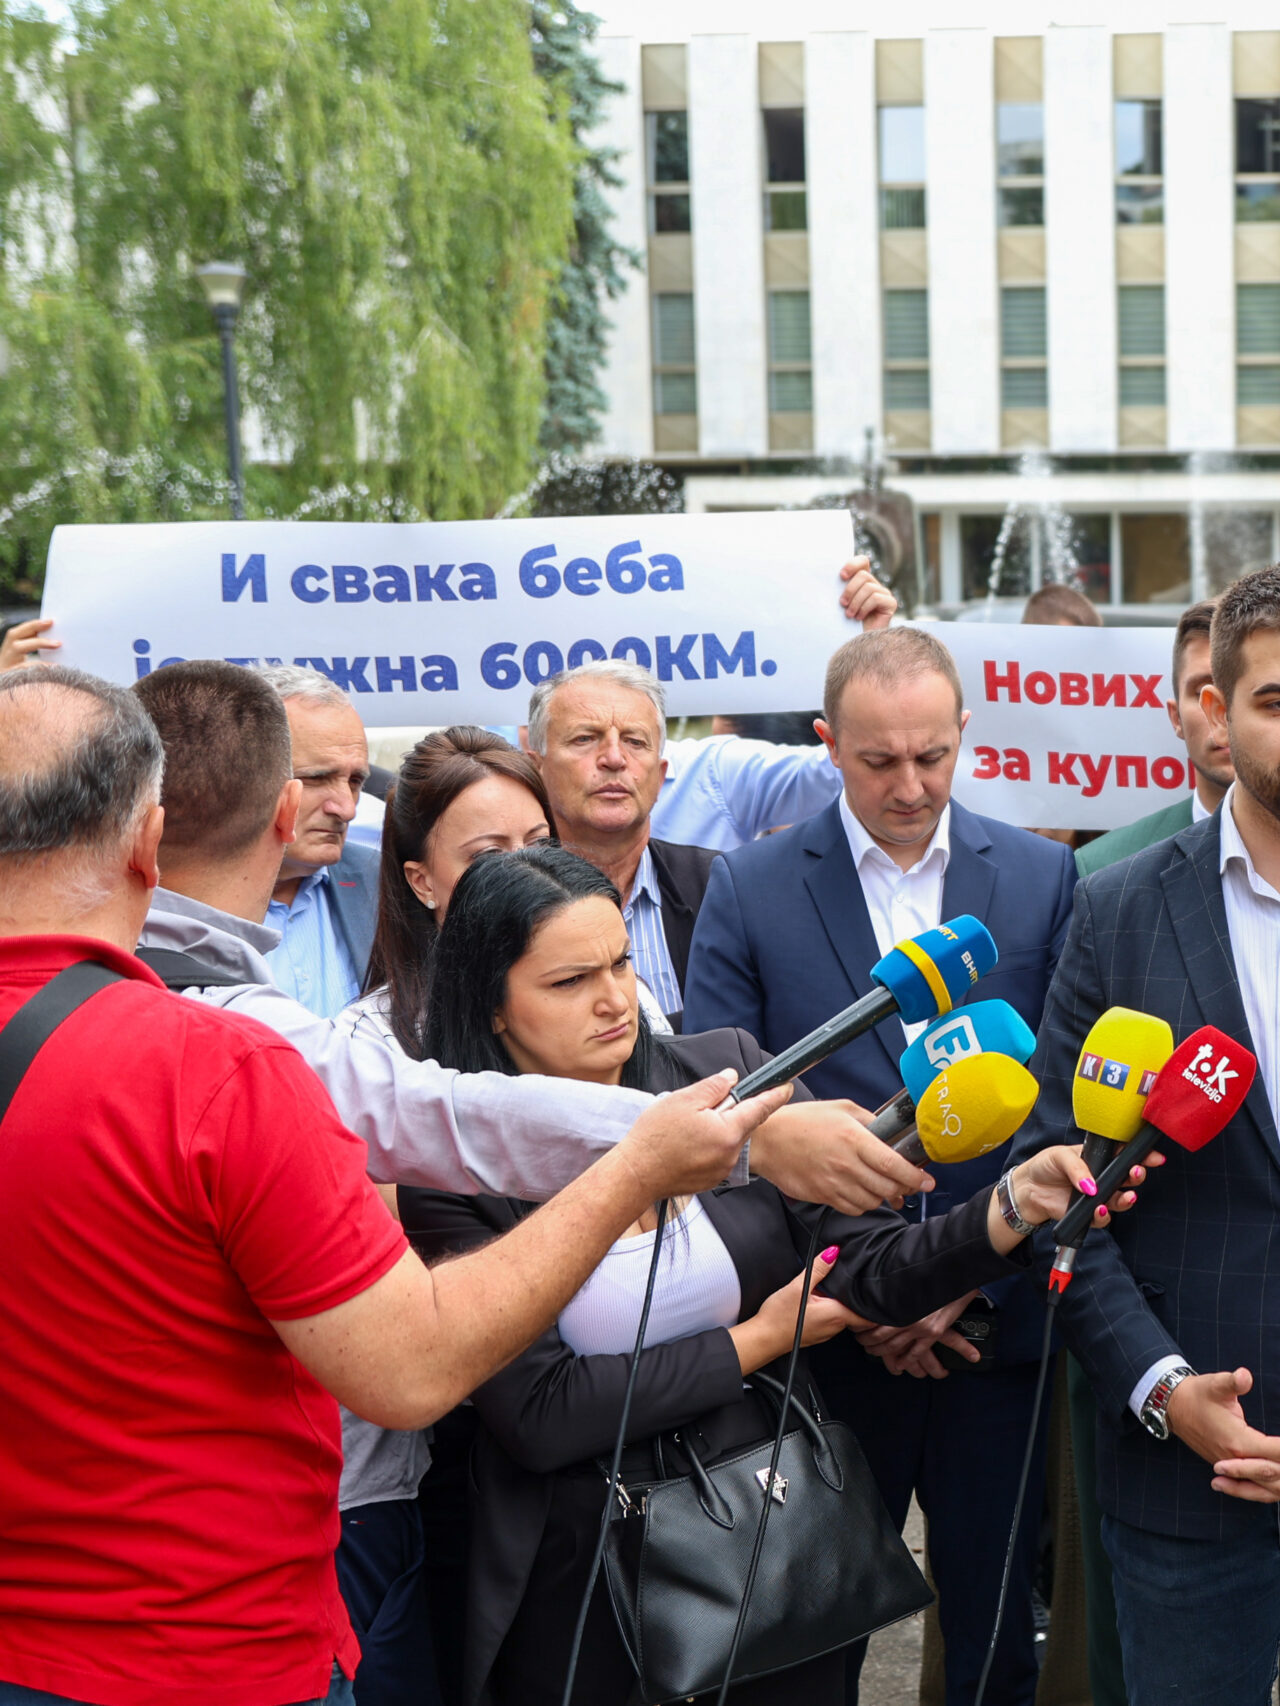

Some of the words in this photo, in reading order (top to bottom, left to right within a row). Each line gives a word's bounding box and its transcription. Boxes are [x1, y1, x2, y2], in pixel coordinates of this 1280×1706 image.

[220, 552, 268, 603] И
[290, 561, 498, 604] свака
[518, 539, 685, 599] беба
[983, 660, 1165, 708] Нових
[971, 745, 1031, 781] за
[1047, 751, 1197, 798] купо
[1181, 1067, 1222, 1103] televizija
